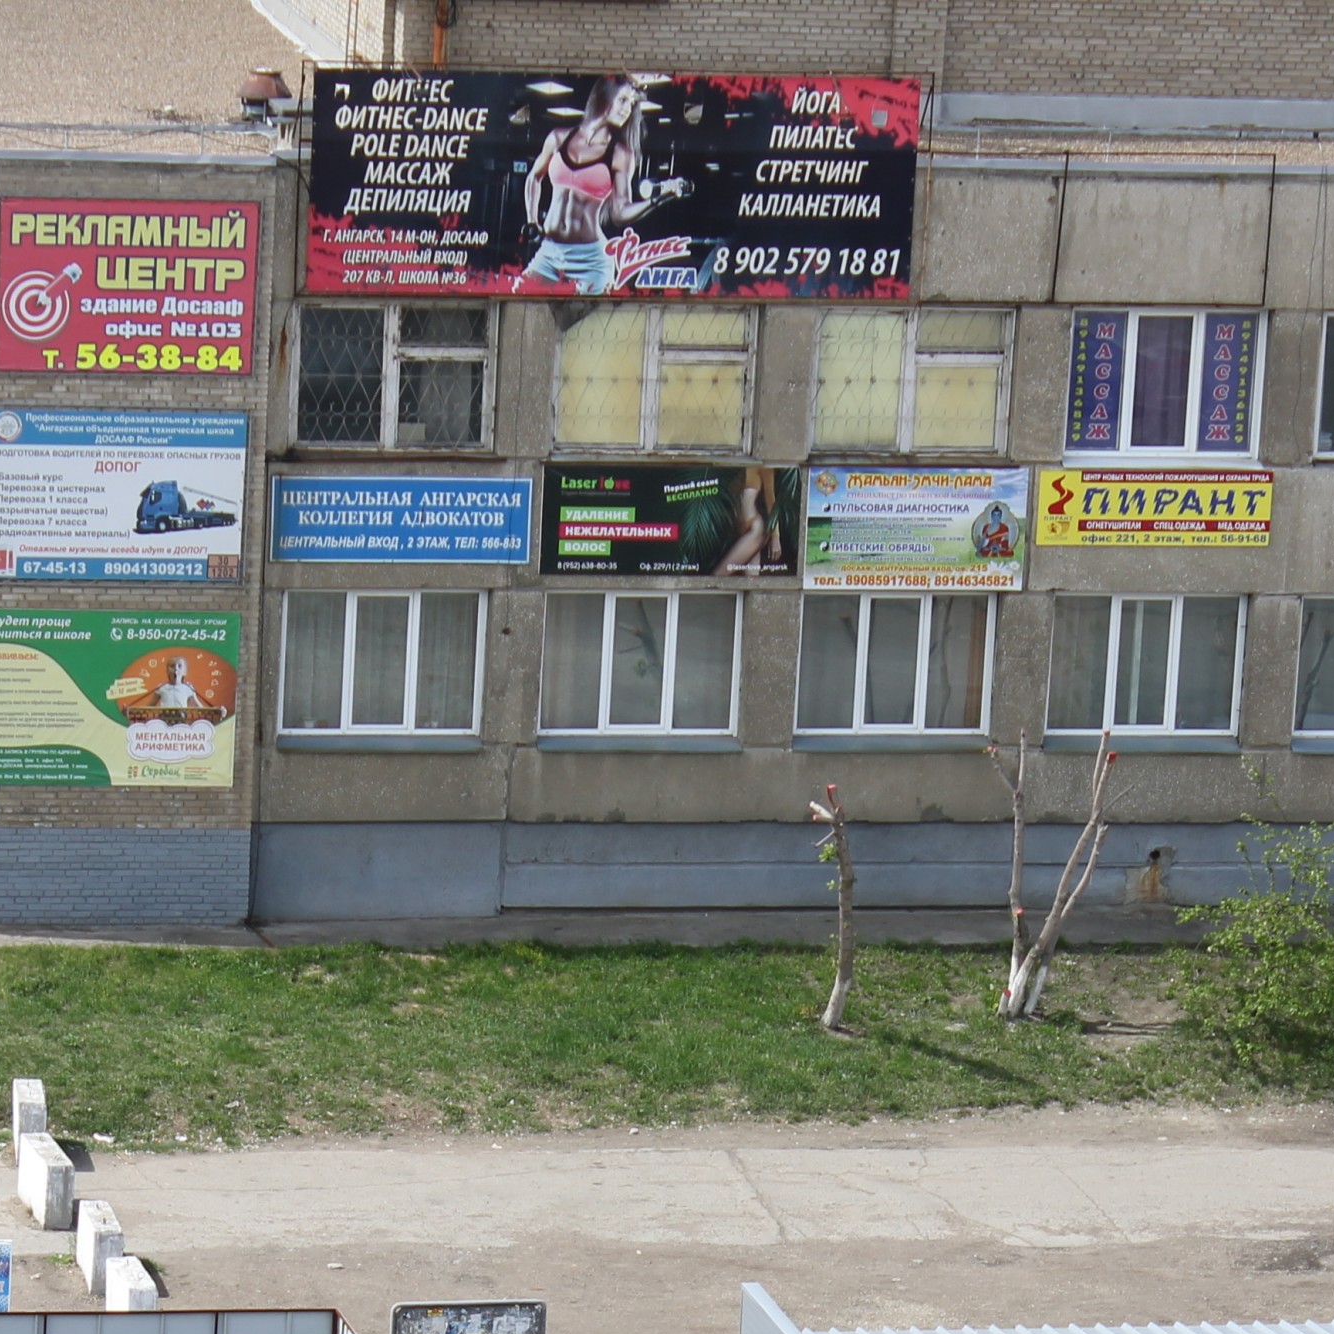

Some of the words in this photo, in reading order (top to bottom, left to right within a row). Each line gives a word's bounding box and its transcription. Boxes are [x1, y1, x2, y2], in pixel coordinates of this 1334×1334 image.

[372, 78, 454, 102] ФИТЕС
[792, 87, 841, 114] ЙОГА
[335, 105, 488, 131] ФИТНЕС-DANCE
[769, 125, 858, 149] ПИЛАТЕС
[351, 134, 401, 157] POLE
[405, 135, 470, 158] DANCE
[364, 162, 453, 184] МАССАЖ
[756, 160, 868, 183] СТРЕТЧИНГ
[343, 189, 471, 216] ДЕПИЛЯЦИЯ
[738, 193, 881, 217] КАЛЛАНЕТИКА
[11, 210, 246, 249] РЕКЛАМНЫЙ
[335, 230, 386, 244] АНГАРСК,
[441, 230, 489, 245] ДОСААФ
[343, 249, 431, 264] (ЦЕНТРАЛЬНЫЙ
[434, 251, 467, 266] ВХОД)
[714, 247, 729, 274] 8
[735, 248, 780, 274] 902
[784, 249, 831, 275] 579
[839, 249, 865, 274] 18
[871, 249, 900, 275] 81
[96, 257, 245, 292] ЦЕНТР
[343, 270, 363, 283] 207
[398, 271, 439, 284] ШКОЛА
[80, 297, 157, 315] здание
[161, 297, 244, 317] Досааф
[105, 320, 162, 339] офис
[171, 322, 241, 338] №103
[76, 343, 243, 371] 56-38-84
[1086, 323, 1116, 439] МАССАЖ
[1206, 324, 1235, 440] МАССАЖ
[25, 413, 112, 424] Профессиональное
[114, 414, 190, 425] образовательное
[192, 417, 244, 426] учреждение
[87, 425, 149, 435] объединенная
[152, 426, 204, 435] техническая
[207, 428, 234, 436] школа
[95, 435, 134, 444] ДОСААФ
[52, 449, 101, 458] ВОДИТЕЛЕЙ
[117, 450, 165, 458] ПЕРЕВОЗКЕ
[167, 451, 208, 459] ОПАСНЫХ
[210, 452, 241, 460] ГРУЗОВ
[94, 461, 142, 474] ДОПОГ
[42, 474, 64, 483] курс
[561, 476, 597, 489] Laser
[1083, 474, 1101, 482] ЦЕНТР
[1103, 474, 1124, 482] НОВЫХ
[1126, 473, 1164, 482] ТЕХНОЛОГИЙ
[1165, 474, 1218, 482] ПОЖАРОТУШЕНИЯ
[57, 484, 106, 494] цистернах
[56, 496, 88, 504] класса
[282, 491, 412, 507] ЦЕНТРАЛЬНАЯ
[419, 492, 521, 507] АНГАРСКАЯ
[1082, 487, 1266, 516] ПИРАНТ
[61, 507, 108, 516] вещества)
[566, 510, 629, 520] УДАЛЕНИЕ
[833, 504, 893, 514] ПУЛЬСОВАЯ
[896, 504, 970, 514] ДИАГНОСТИКА
[55, 518, 87, 526] класса
[298, 511, 393, 525] КОЛЛЕГИЯ
[400, 511, 504, 528] АДВОКАТОВ
[1086, 521, 1141, 530] ОГНЕТУШИТЕЛИ
[1153, 521, 1206, 531] СПЕЦ.ОДЕЖДА
[1217, 522, 1266, 531] МЕД.ОДЕЖДА
[75, 529, 130, 538] материалы)
[566, 527, 671, 537] НЕЖЕЛАТЕЛЬНЫХ
[279, 534, 365, 548] ЦЕНТРАЛЬНЫЙ
[416, 537, 450, 550] ЭТАЖ,
[1081, 534, 1112, 544] офис
[1154, 535, 1185, 544] этаж,
[1221, 534, 1267, 543] 56-91-68
[19, 545, 67, 553] Отважные
[69, 546, 109, 555] мужчины
[565, 543, 606, 552] ВОЛОС
[831, 543, 886, 552] ТИБЕТСКИЕ
[889, 544, 933, 553] ОБРЯДЫ:
[23, 562, 87, 574] 67-45-13
[104, 563, 203, 575] 89041309212
[211, 568, 234, 578] 1202
[814, 577, 842, 585] тел.:
[846, 575, 931, 588] 89085917688;
[934, 576, 1014, 586] 89146345821
[32, 618, 71, 628] проще
[53, 630, 91, 640] школе
[127, 629, 226, 641] 8-950-072-45-42
[136, 732, 206, 742] МЕНТАЛЬНАЯ
[135, 742, 205, 752] АРИФМЕТИКА
